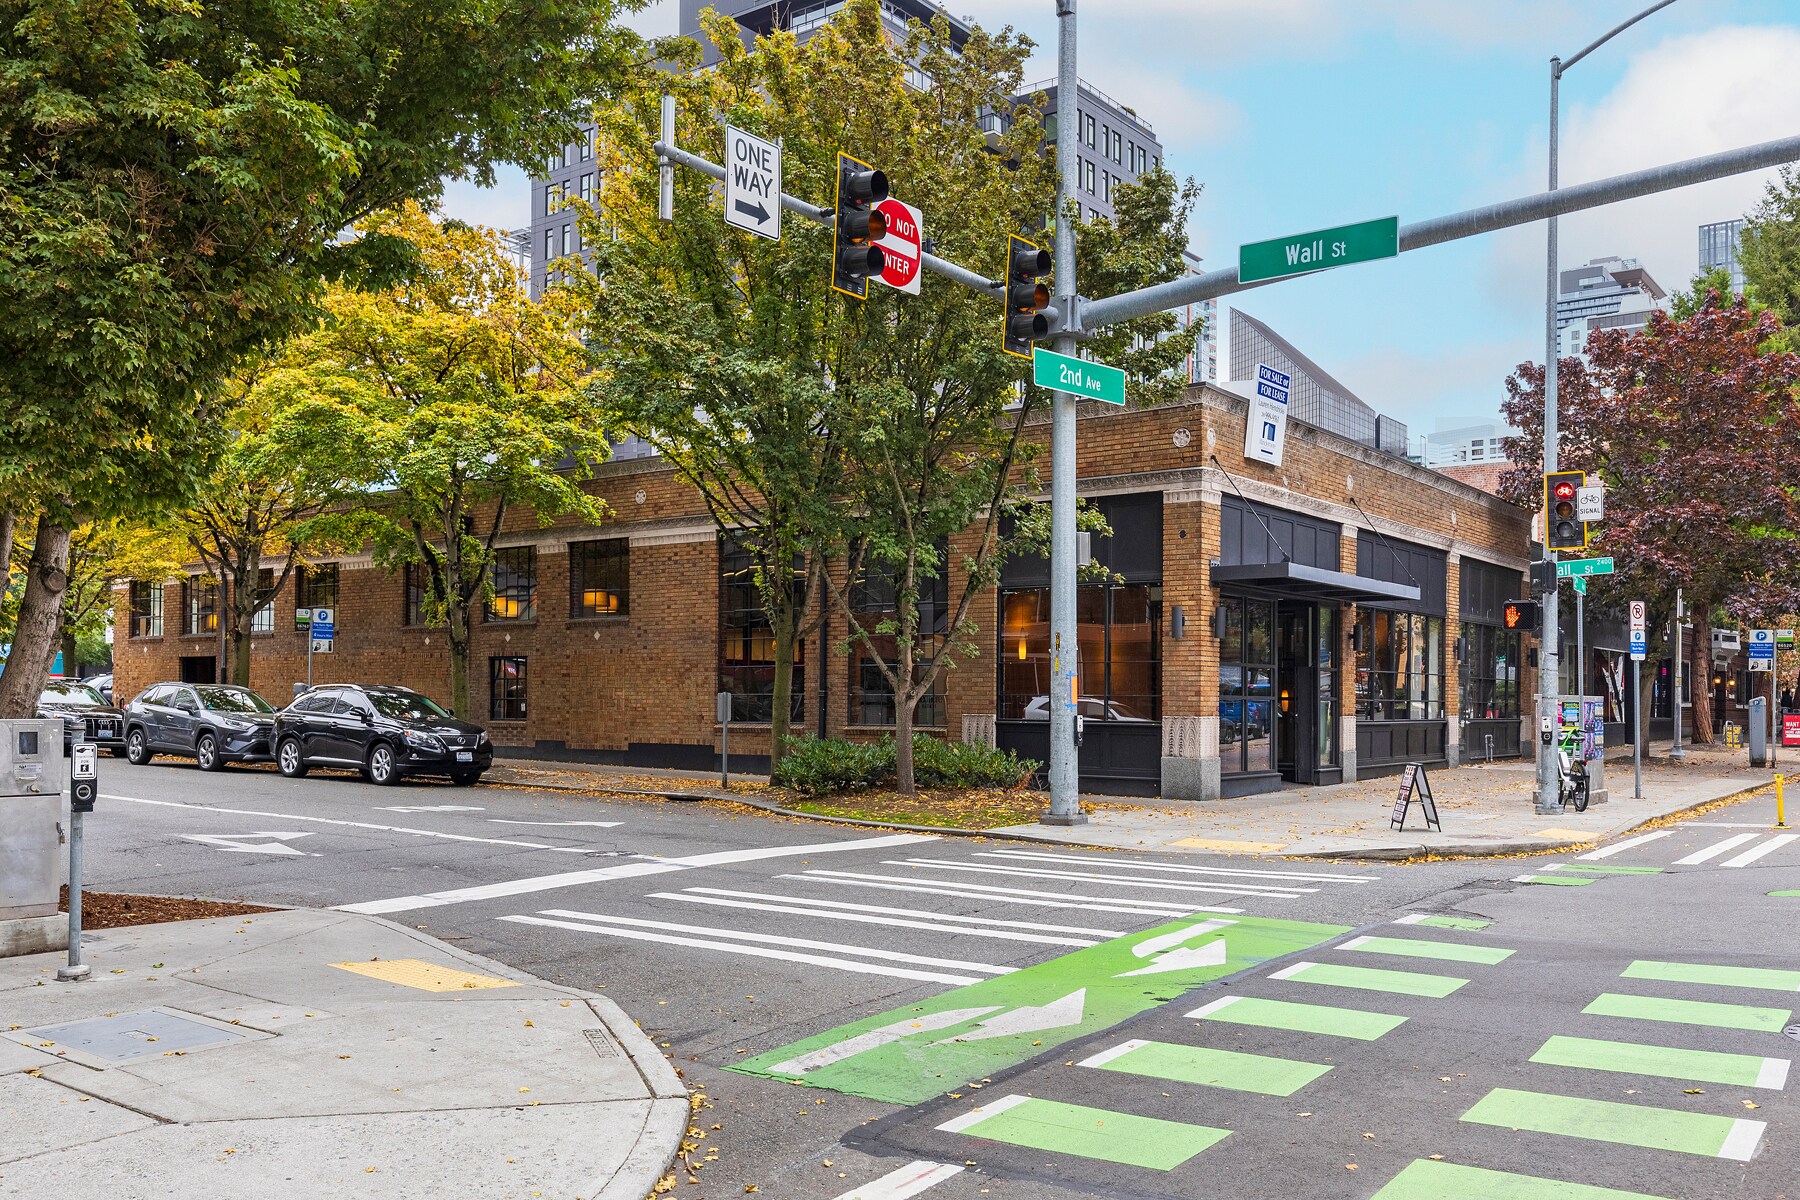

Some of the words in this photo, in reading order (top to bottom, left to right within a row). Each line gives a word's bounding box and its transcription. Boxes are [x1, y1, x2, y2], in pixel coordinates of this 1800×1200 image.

[735, 138, 772, 173] ONE
[734, 163, 773, 198] WAY
[896, 218, 915, 238] NOT
[883, 252, 910, 275] NTER
[1285, 240, 1323, 266] Wall
[1331, 242, 1346, 258] St
[1059, 364, 1082, 387] 2nd
[1086, 374, 1101, 392] Ave
[1261, 367, 1271, 379] FOR
[1271, 372, 1283, 385] SALE
[1260, 384, 1271, 396] FOR
[1272, 388, 1286, 402] LEASE
[1557, 564, 1571, 576] all
[1585, 565, 1594, 574] St
